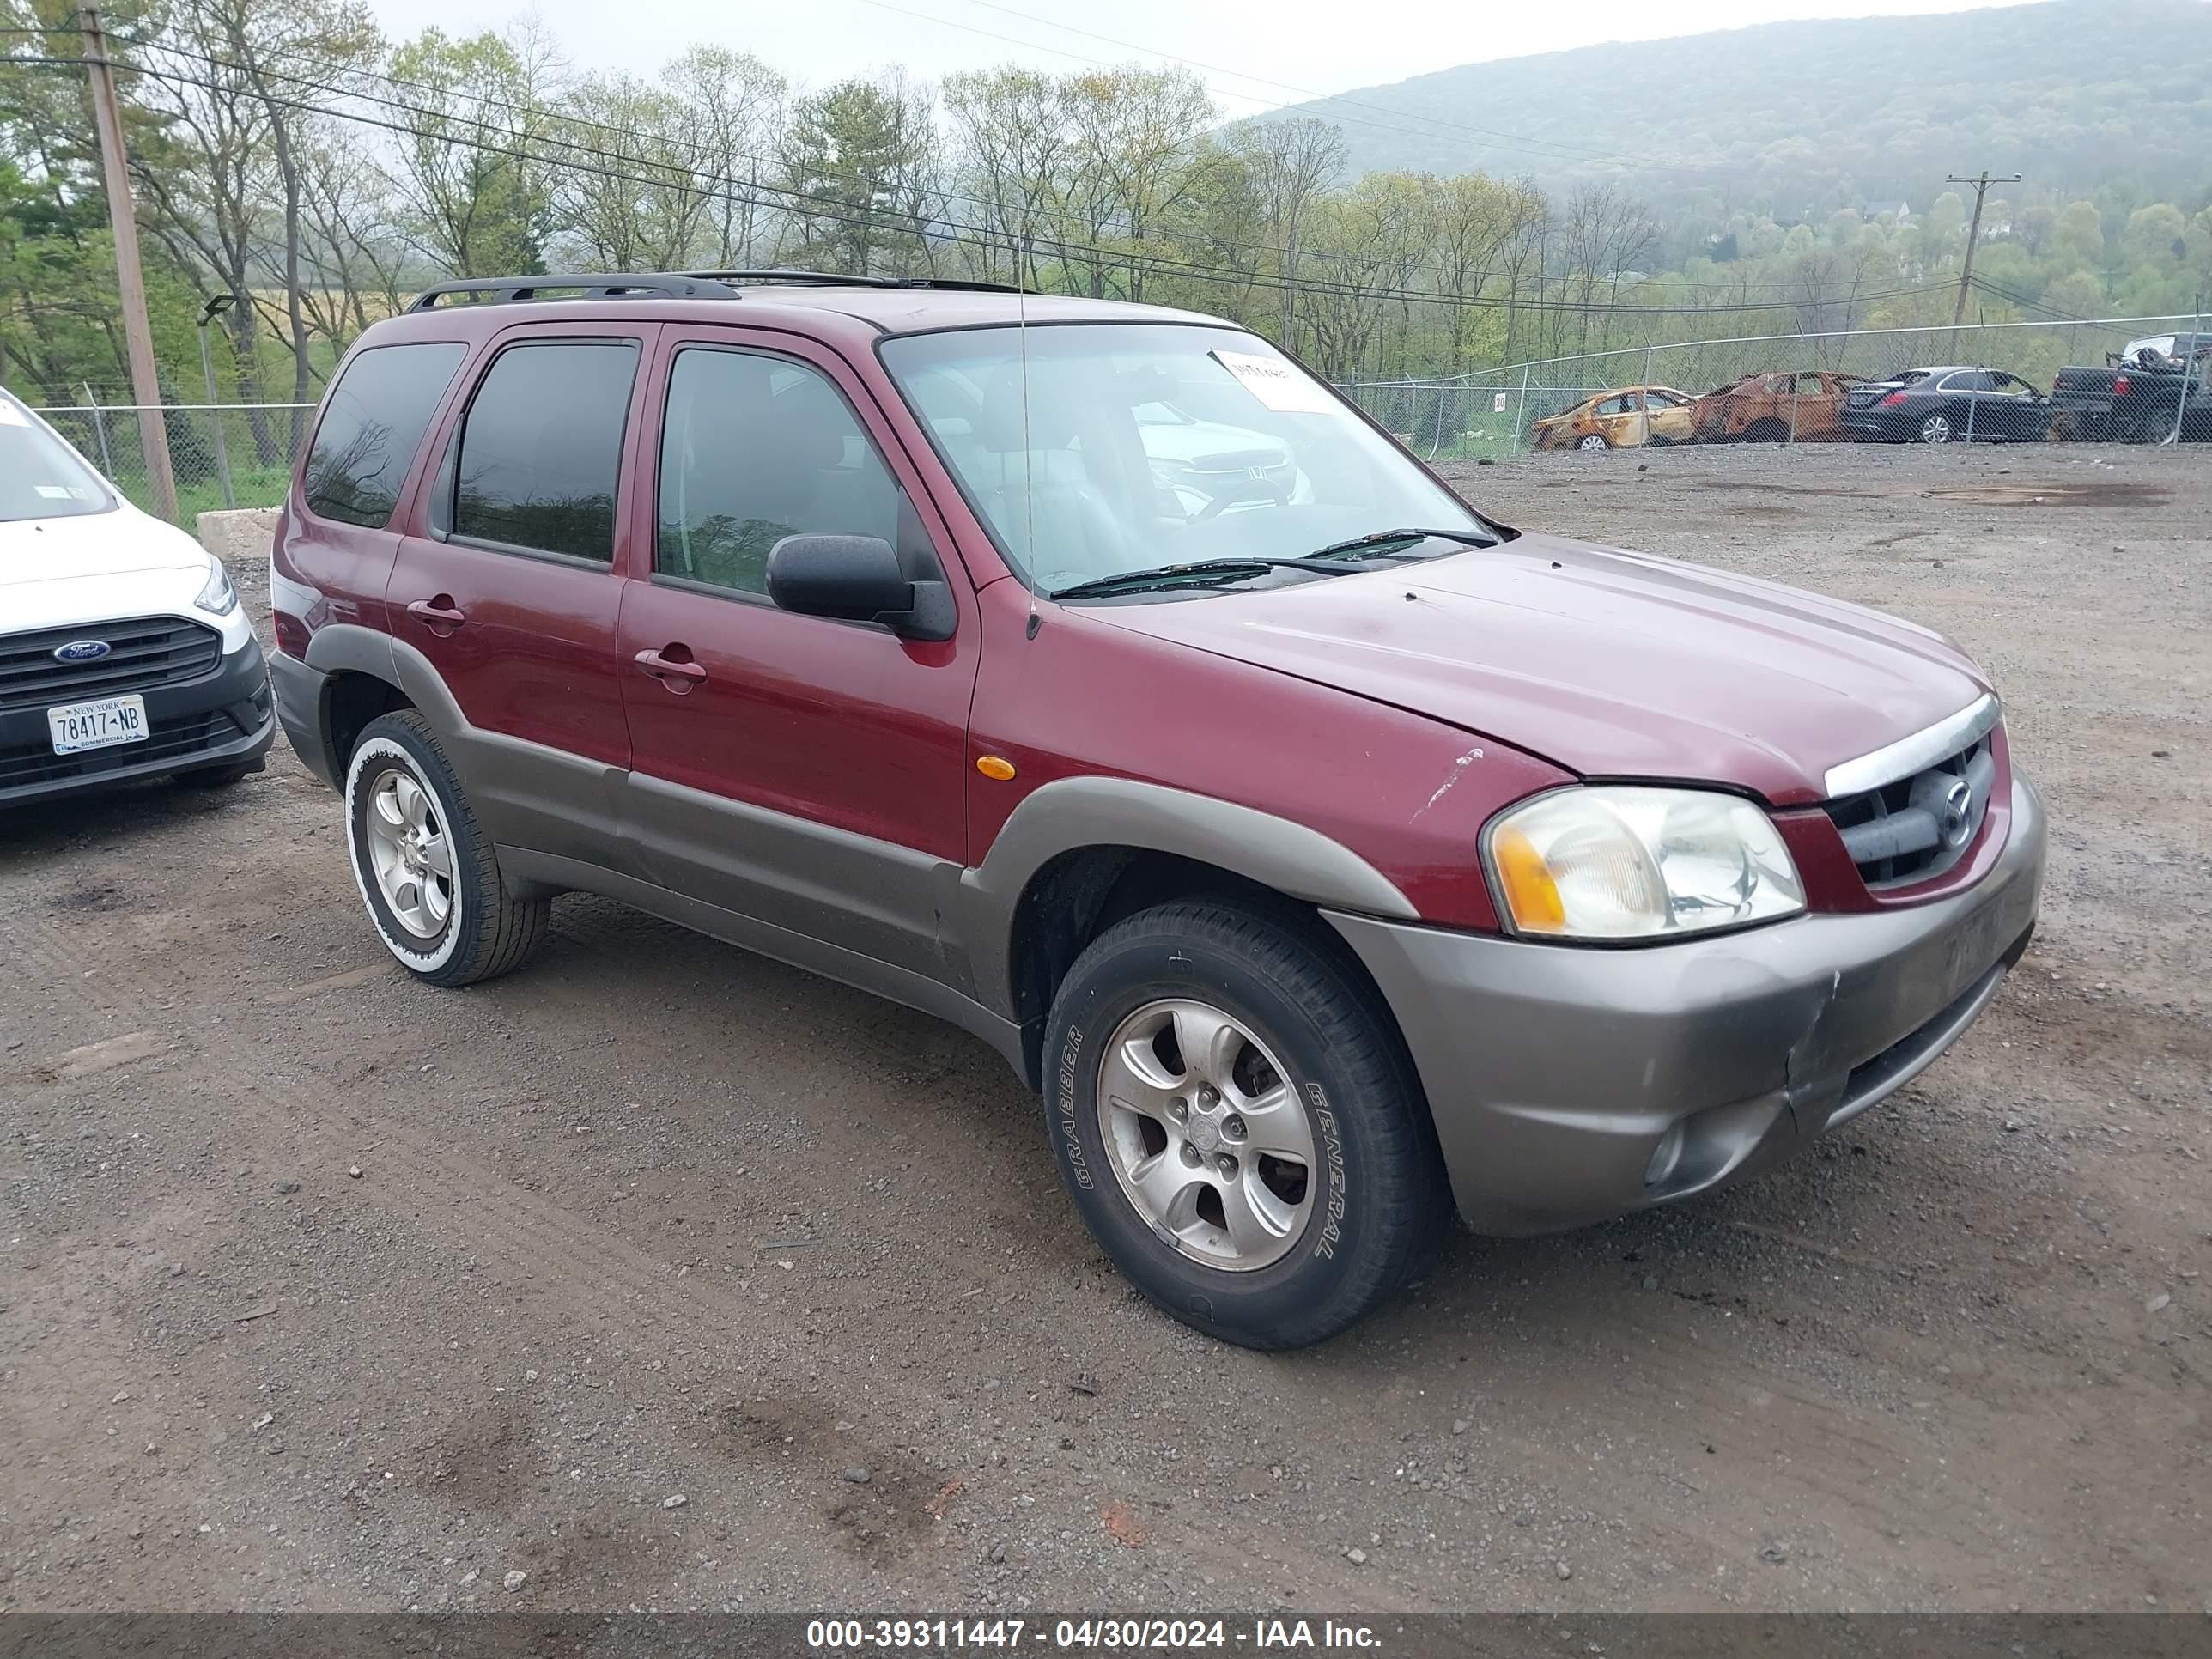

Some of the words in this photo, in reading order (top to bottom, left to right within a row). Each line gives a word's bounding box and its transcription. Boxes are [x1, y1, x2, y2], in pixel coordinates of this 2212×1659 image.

[1496, 398, 1504, 408] 30
[70, 644, 99, 658] Ford
[73, 706, 94, 715] NEW
[97, 702, 120, 711] YORK
[81, 736, 124, 746] COMMERCIAL
[1059, 1024, 1094, 1189] GRABBER
[1305, 1082, 1346, 1260] GENERAL
